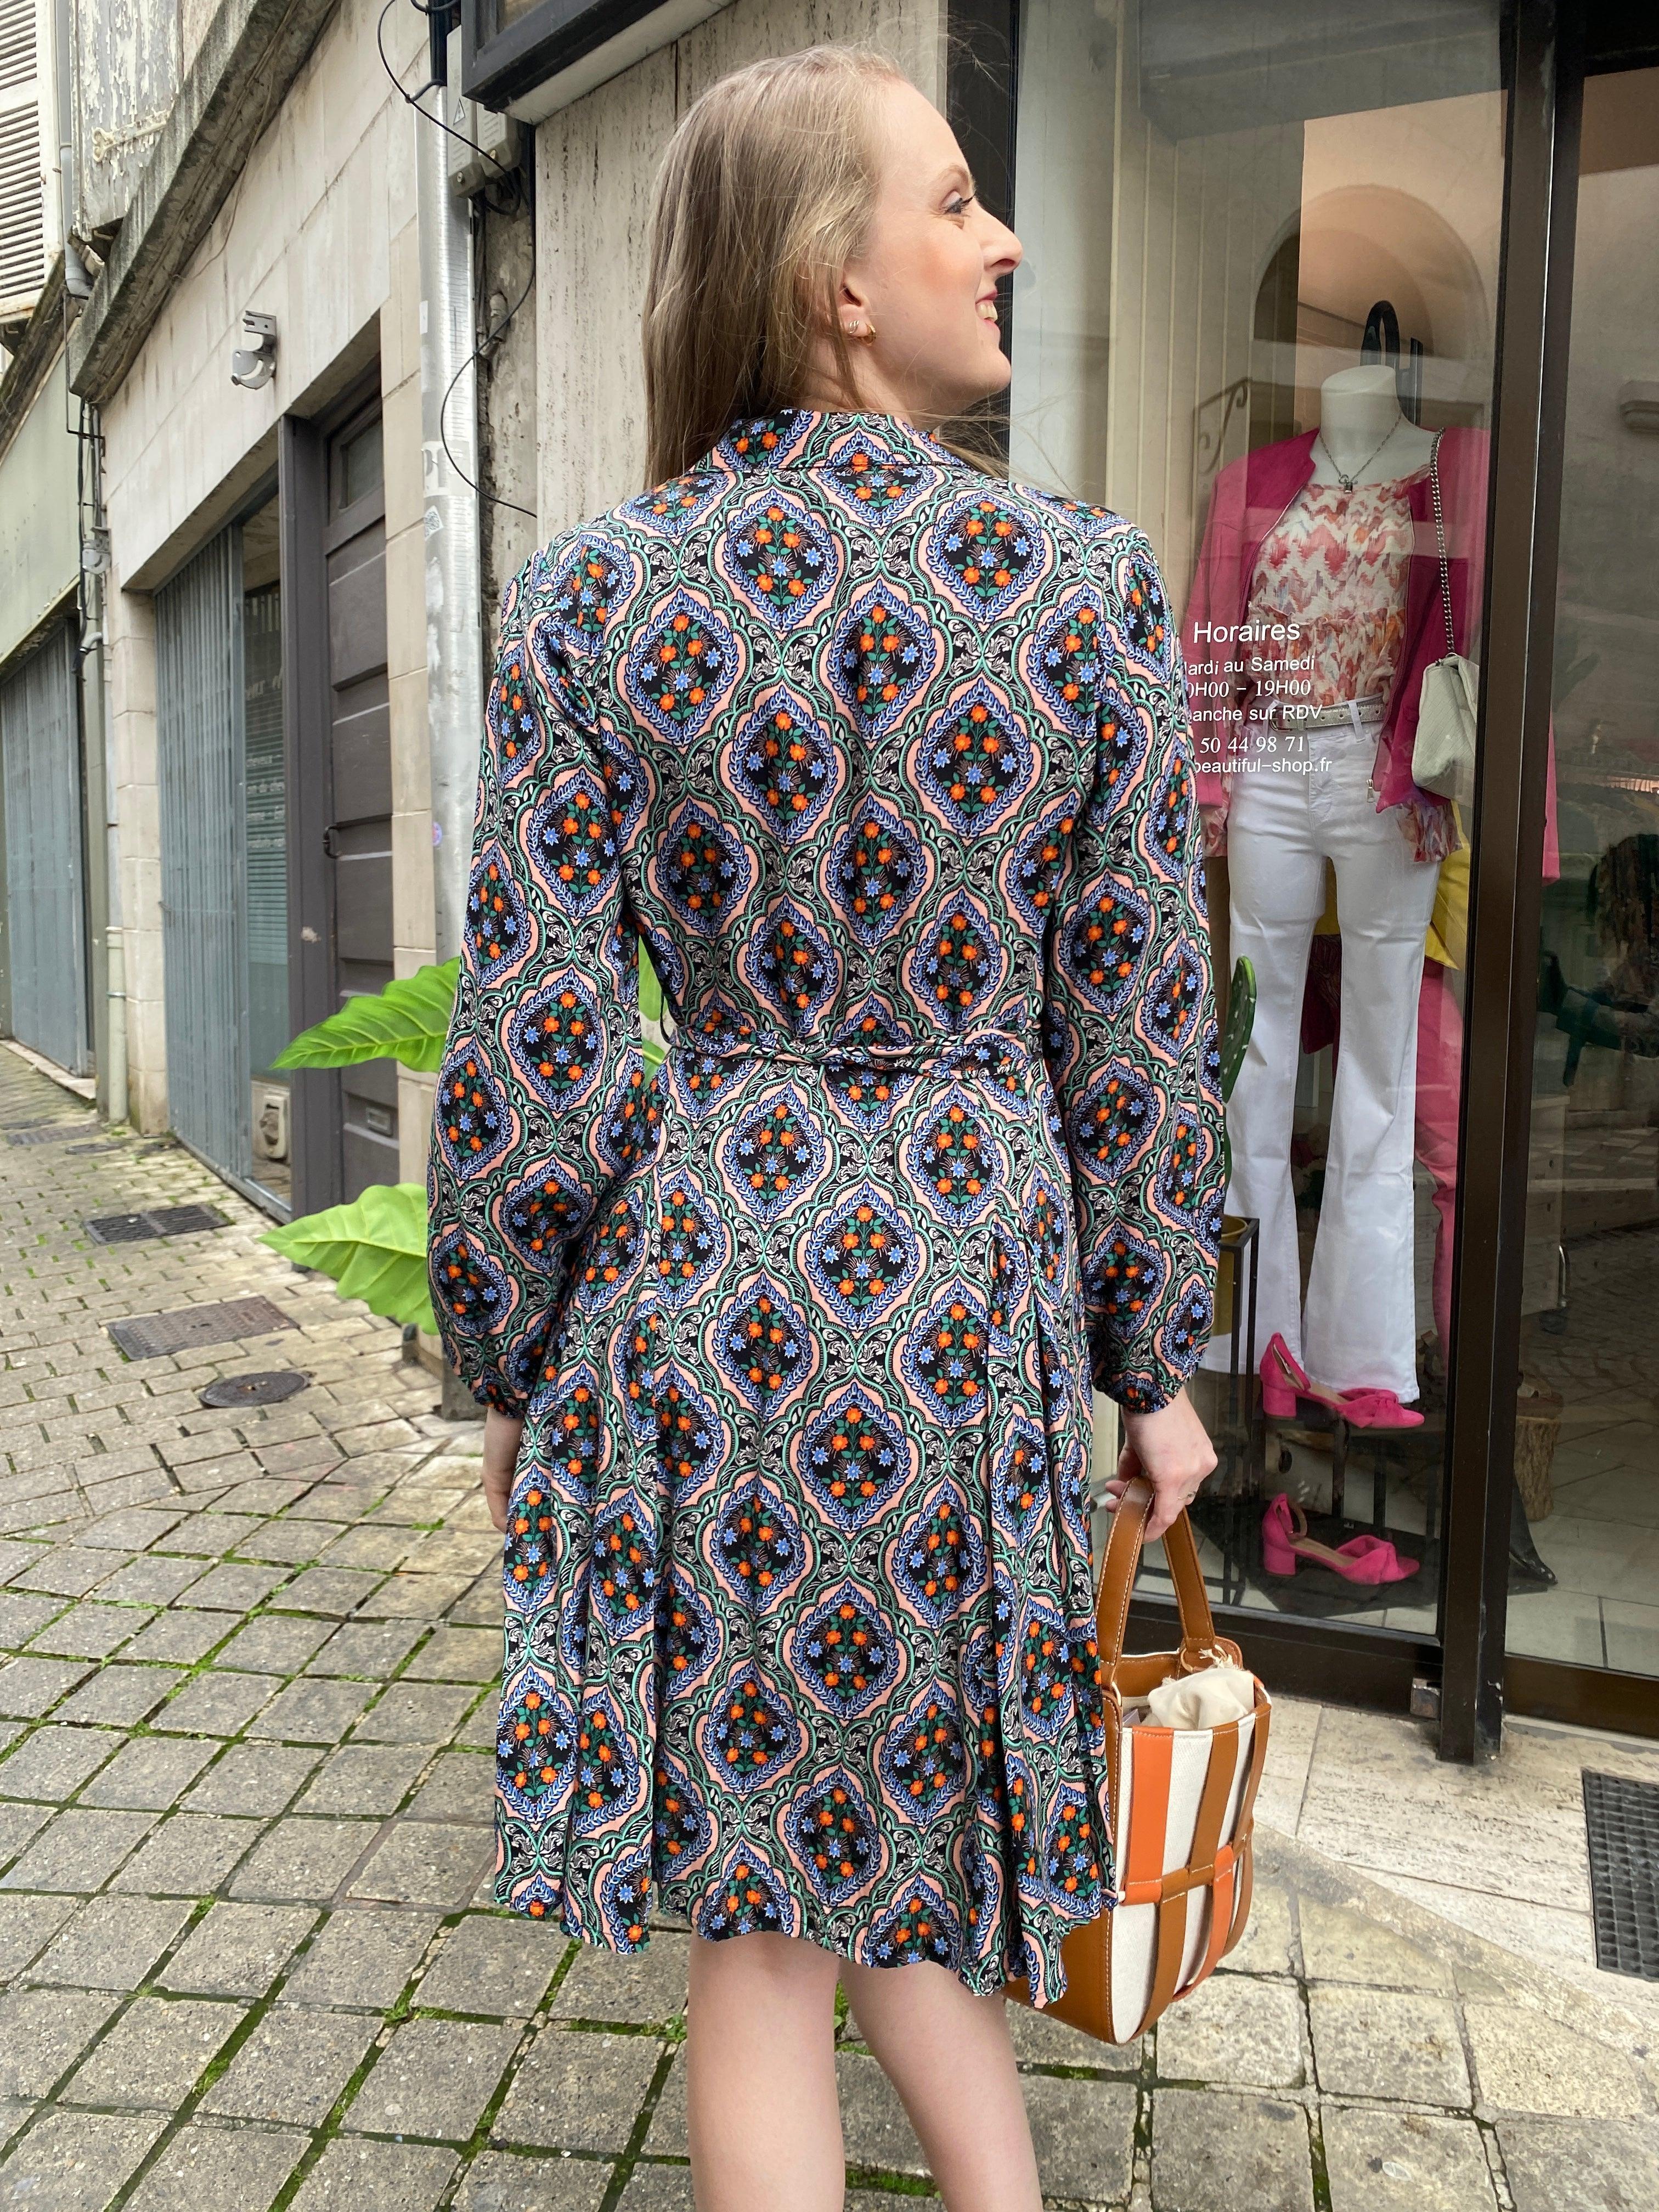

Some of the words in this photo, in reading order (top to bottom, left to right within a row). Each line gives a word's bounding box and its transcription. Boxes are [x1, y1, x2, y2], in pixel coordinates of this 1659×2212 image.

[1193, 620, 1301, 644] Horaires
[1223, 661, 1244, 673] au
[1250, 655, 1315, 673] Samedi
[1187, 681, 1229, 698] 0H00
[1255, 679, 1311, 697] 19H00
[1189, 706, 1243, 722] anche
[1249, 707, 1277, 721] sur
[1282, 704, 1324, 720] RDV
[1199, 737, 1221, 754] 50
[1227, 736, 1249, 753] 44
[1256, 736, 1277, 752] 98
[1285, 736, 1305, 752] 71
